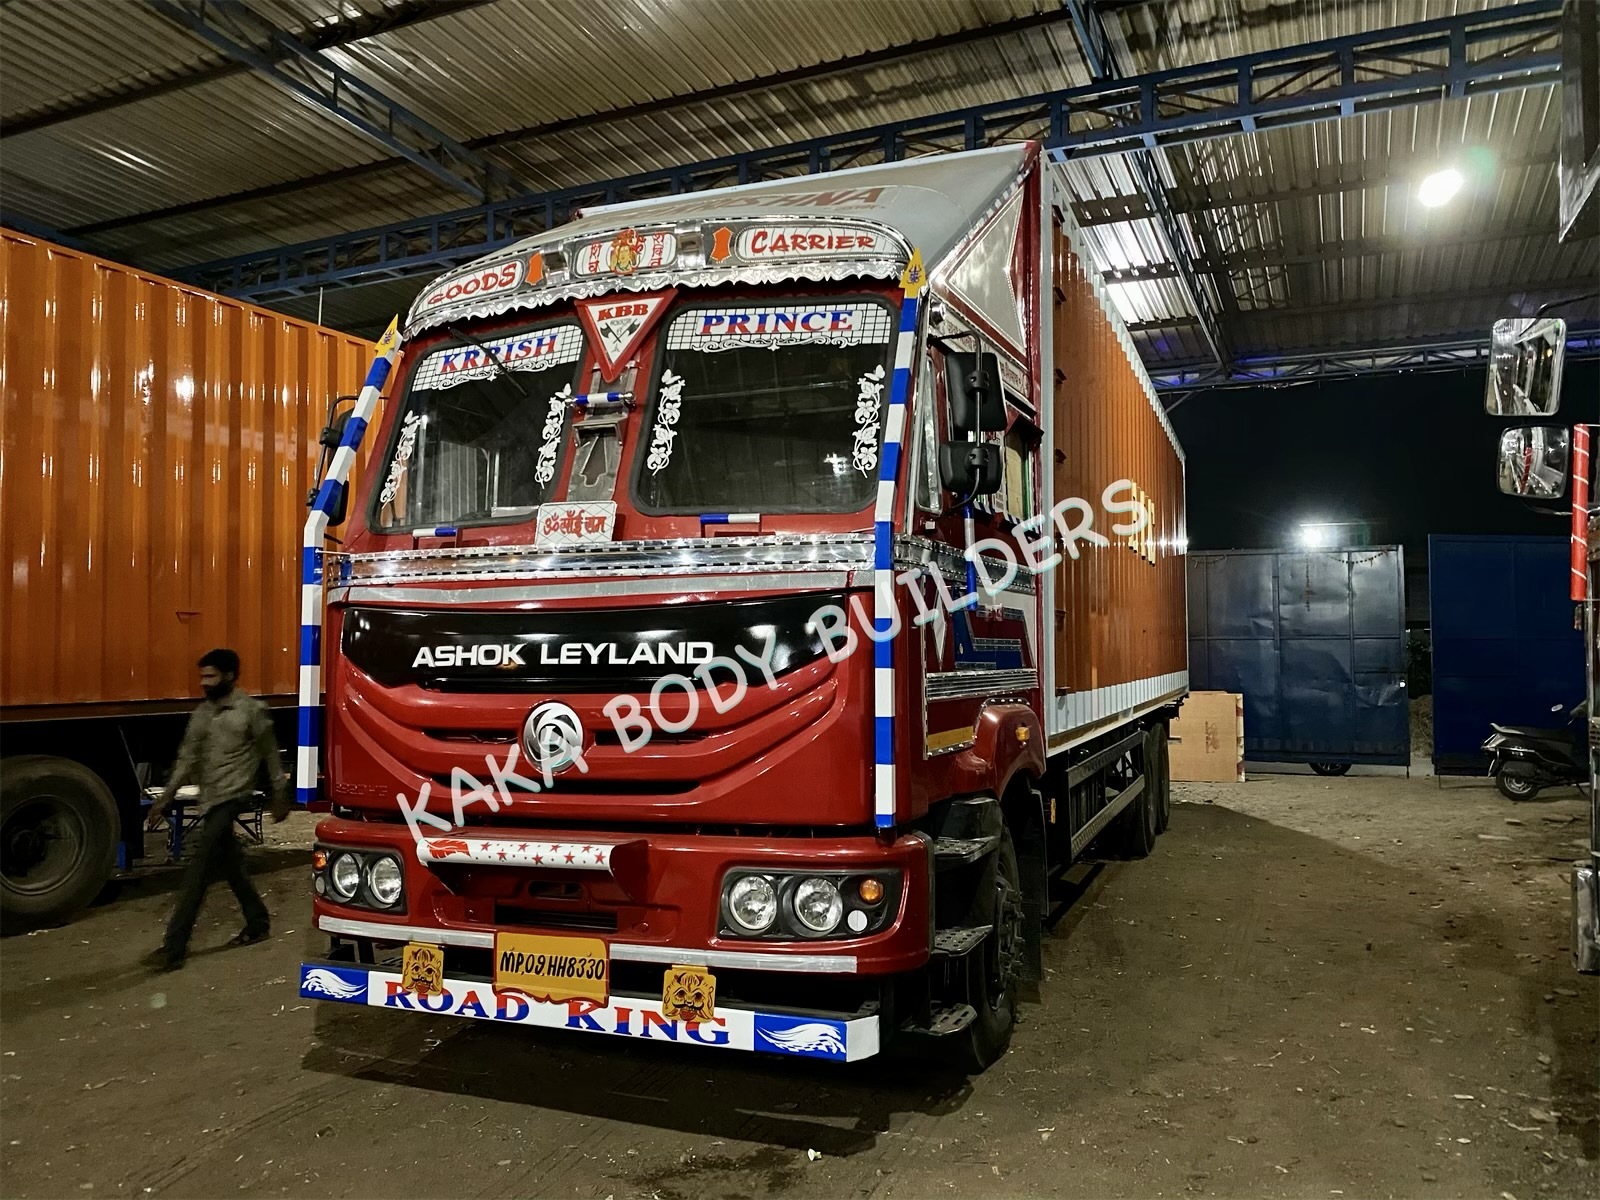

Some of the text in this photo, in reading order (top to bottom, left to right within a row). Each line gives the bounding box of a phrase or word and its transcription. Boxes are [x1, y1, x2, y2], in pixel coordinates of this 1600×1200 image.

[428, 231, 876, 305] GOODS CARRIER
[597, 304, 649, 321] KBB
[700, 310, 853, 335] PRINCE
[440, 334, 558, 374] KRRISH
[412, 641, 714, 668] ASHOK LEYLAND
[384, 981, 730, 1045] ROAD KING
